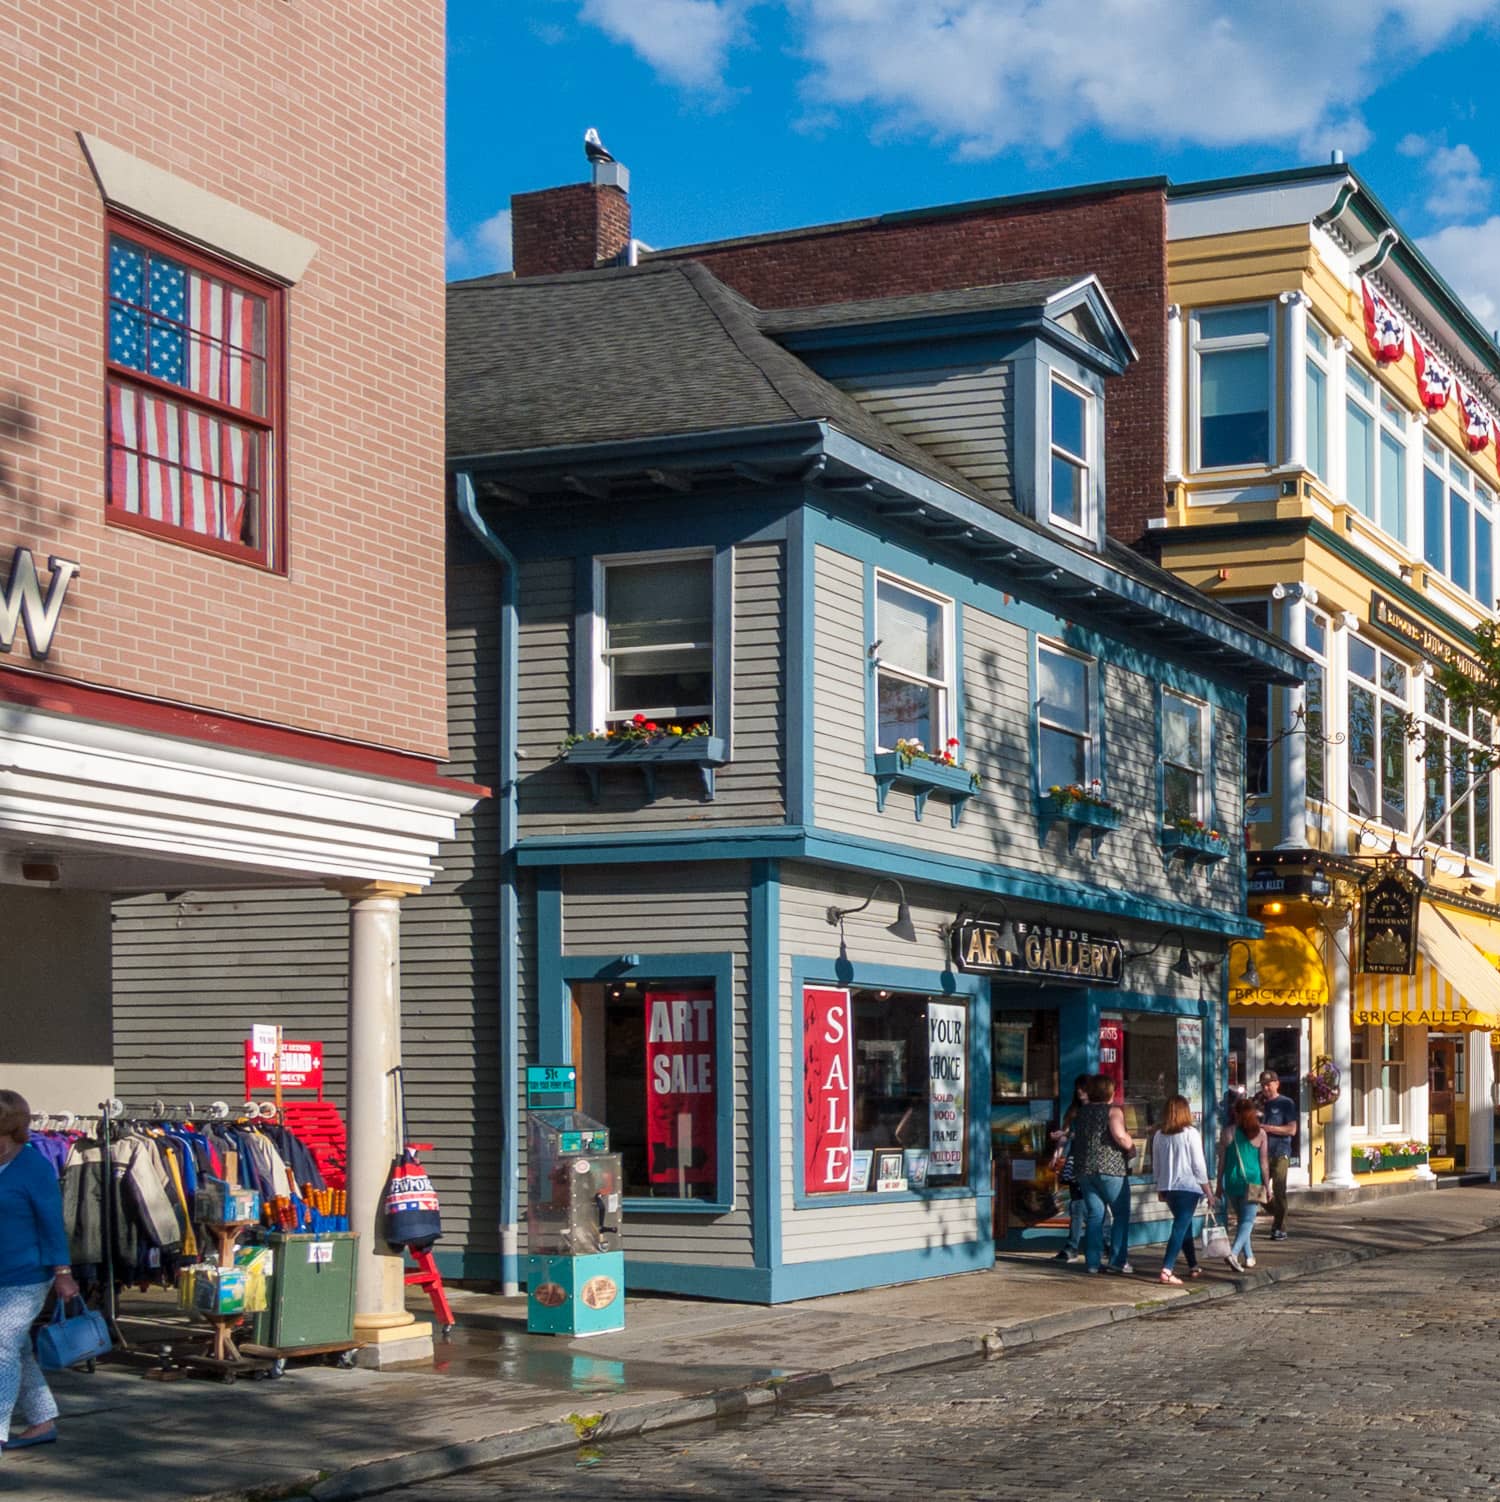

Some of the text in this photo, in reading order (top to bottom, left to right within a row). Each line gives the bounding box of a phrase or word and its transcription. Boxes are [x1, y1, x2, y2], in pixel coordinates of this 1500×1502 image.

[1266, 880, 1285, 889] ALLEY
[1018, 923, 1089, 942] EASIDE
[1025, 935, 1117, 978] GALLERY
[1236, 989, 1322, 1000] BRICK ALLEY
[650, 1001, 712, 1043] ART
[1360, 1010, 1473, 1023] BRICK ALLEY
[930, 1019, 961, 1044] YOUR
[654, 1054, 711, 1094] SALE
[821, 1006, 848, 1184] SALE
[933, 1094, 953, 1102] SOLID
[933, 1131, 957, 1141] FRAME
